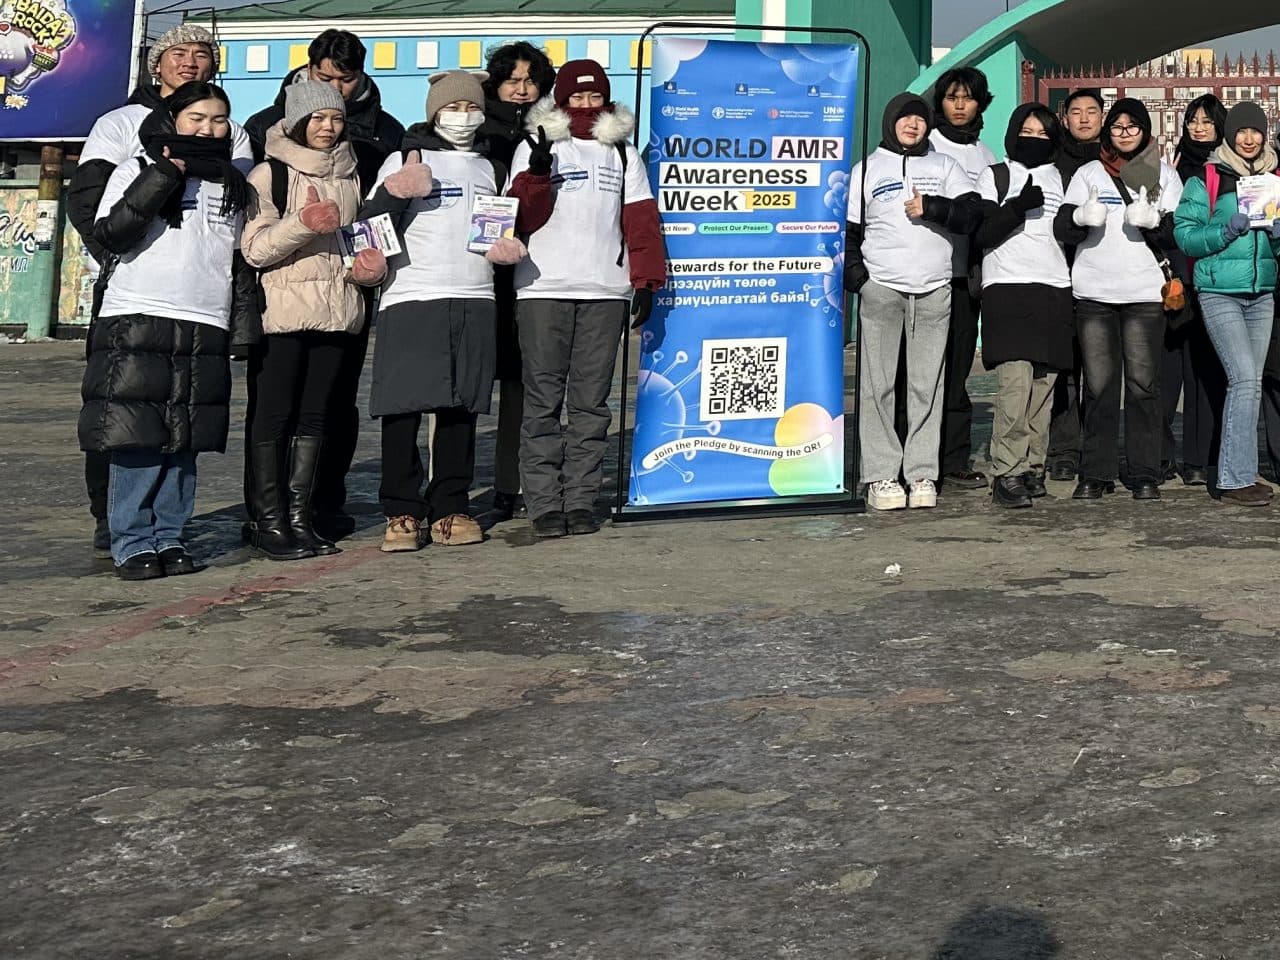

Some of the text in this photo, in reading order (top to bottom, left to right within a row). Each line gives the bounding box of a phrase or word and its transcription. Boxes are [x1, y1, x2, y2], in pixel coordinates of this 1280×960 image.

[664, 137, 838, 159] WORLD AMR
[663, 163, 808, 185] Awareness
[663, 190, 791, 212] Week 2025
[729, 260, 749, 272] for
[752, 260, 775, 271] the
[778, 259, 822, 271] Future
[734, 277, 777, 288] төлөө
[656, 291, 810, 308] хариуцлагатай байя!
[652, 439, 822, 461] Join the Pledge by scanning the QR!
